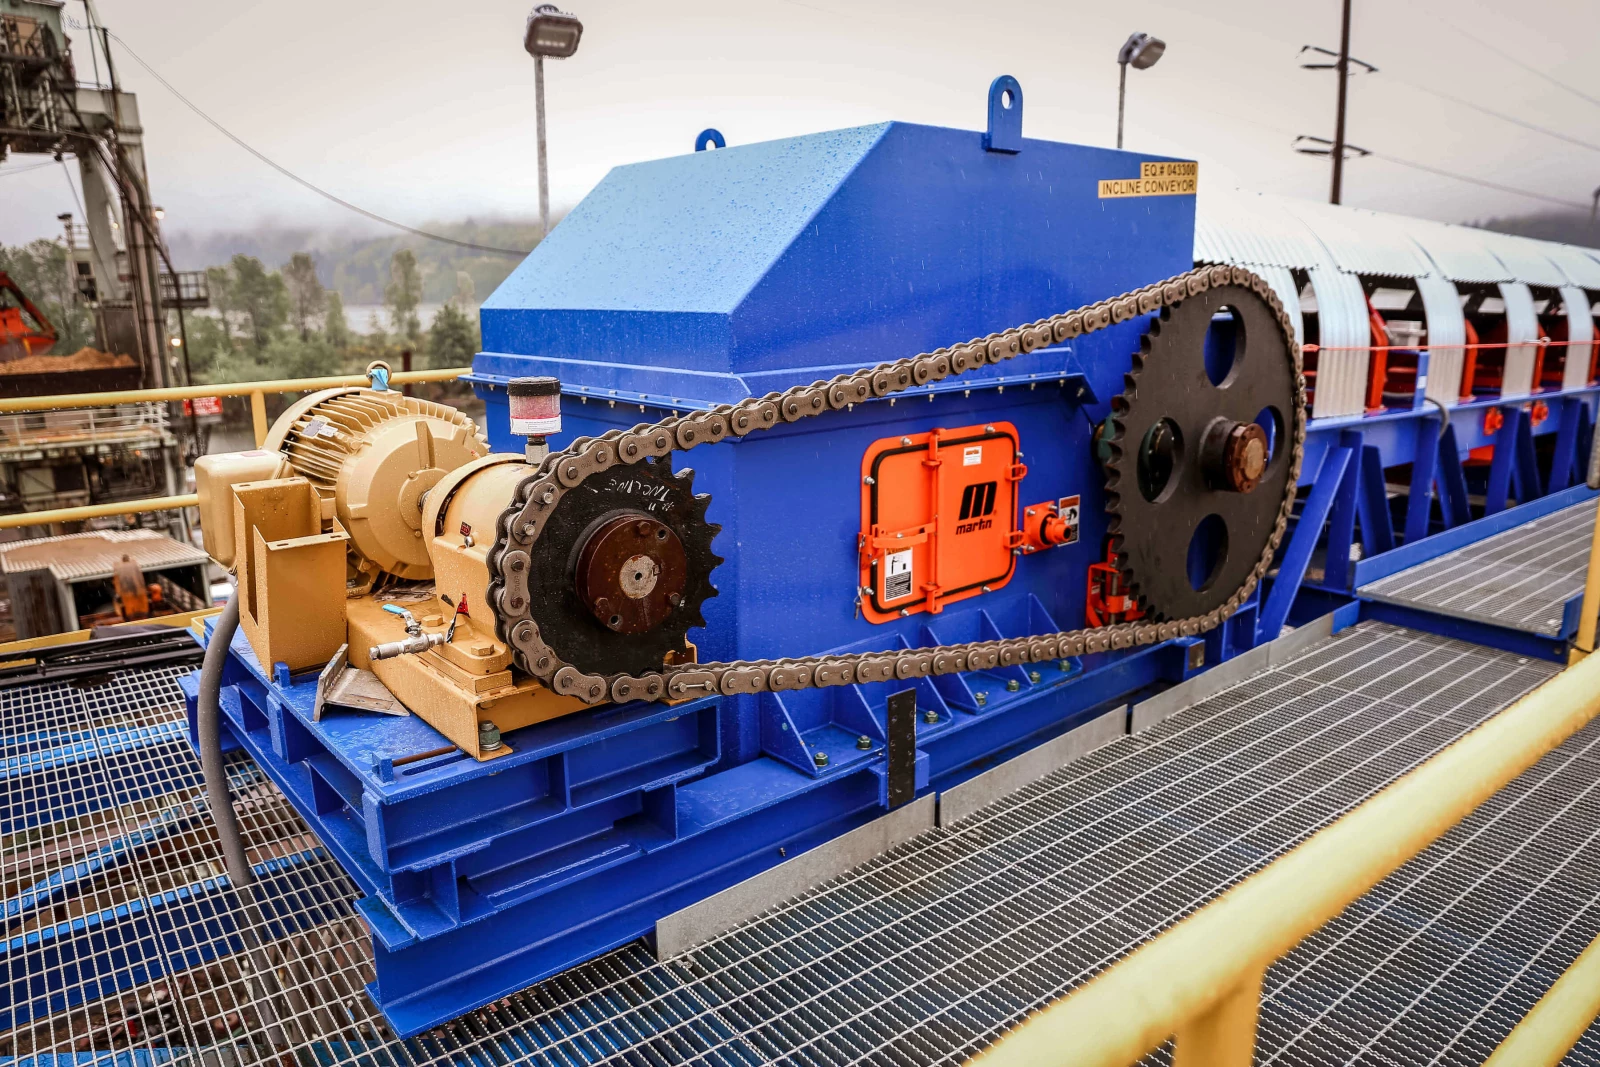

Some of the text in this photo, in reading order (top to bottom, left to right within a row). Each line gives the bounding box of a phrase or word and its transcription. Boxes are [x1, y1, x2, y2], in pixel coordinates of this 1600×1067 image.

[1102, 179, 1195, 195] INCLINE CONVEYOR
[955, 518, 993, 535] martin
